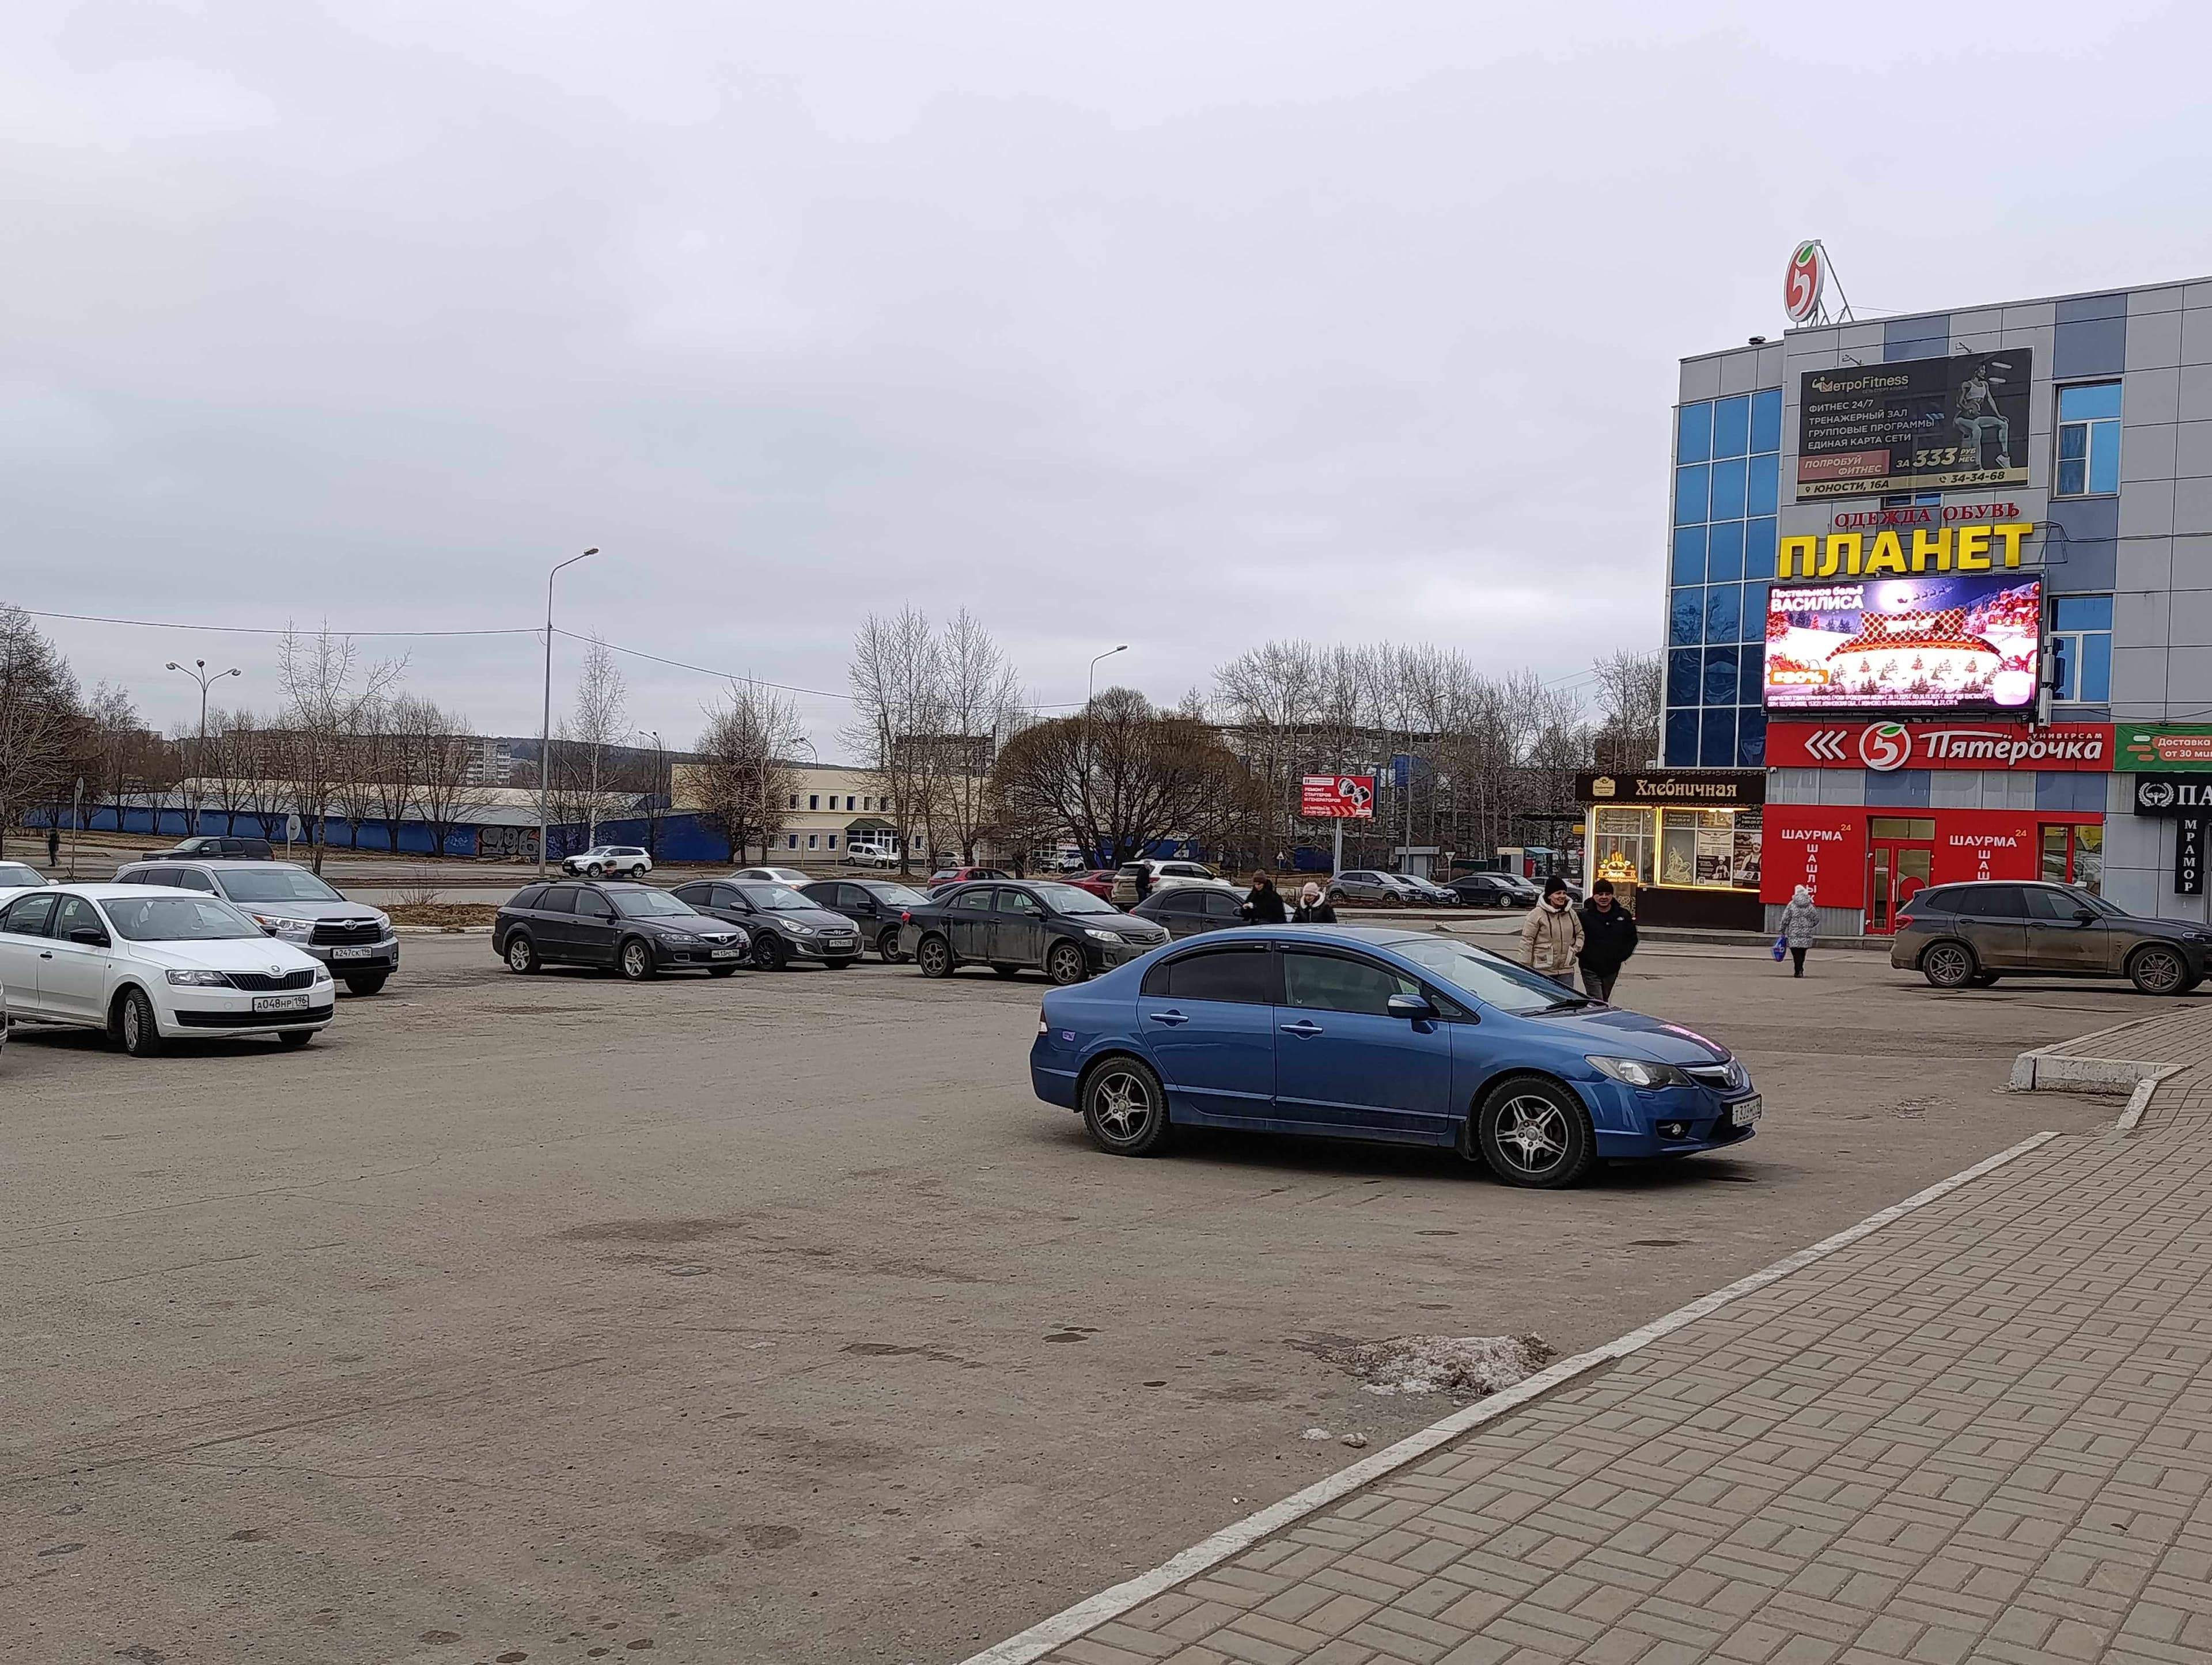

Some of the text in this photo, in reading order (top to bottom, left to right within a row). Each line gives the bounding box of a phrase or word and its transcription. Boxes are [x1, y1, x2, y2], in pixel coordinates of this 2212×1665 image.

[1809, 399, 1873, 412] ФИТНЕС 24/7
[1809, 409, 1907, 425] ТРЕНАЖЕРНЫЙ ЗАЛ
[1808, 419, 1934, 437] ГРУППОВЫЕ ПРОГРАММЫ
[1808, 434, 1911, 450] ЕДИНАЯ КАРТА СЕТИ
[1804, 455, 1862, 468] ПОПРОБУЙ
[1896, 447, 1958, 468] ЗА 333
[1838, 465, 1882, 475] ФИТНЕС
[1951, 471, 2005, 483] 34-34-68
[1814, 480, 1889, 493] ЮНОСТИ, 16А
[1834, 502, 2021, 528] ОДЕЖДА ОБУВЬ
[1778, 522, 2033, 578] ПЛАНЕТ
[1771, 595, 1863, 612] ВАСИЛИСА
[1919, 730, 2103, 765] Пятёрочка
[2158, 738, 2210, 746] Доставка
[1635, 779, 1737, 797] Хлебничная
[1782, 829, 1843, 841] ШАУРМА
[1949, 835, 2017, 847] ШАУРМА
[2183, 820, 2197, 891] МРАМОР
[257, 999, 291, 1009] А048НР
